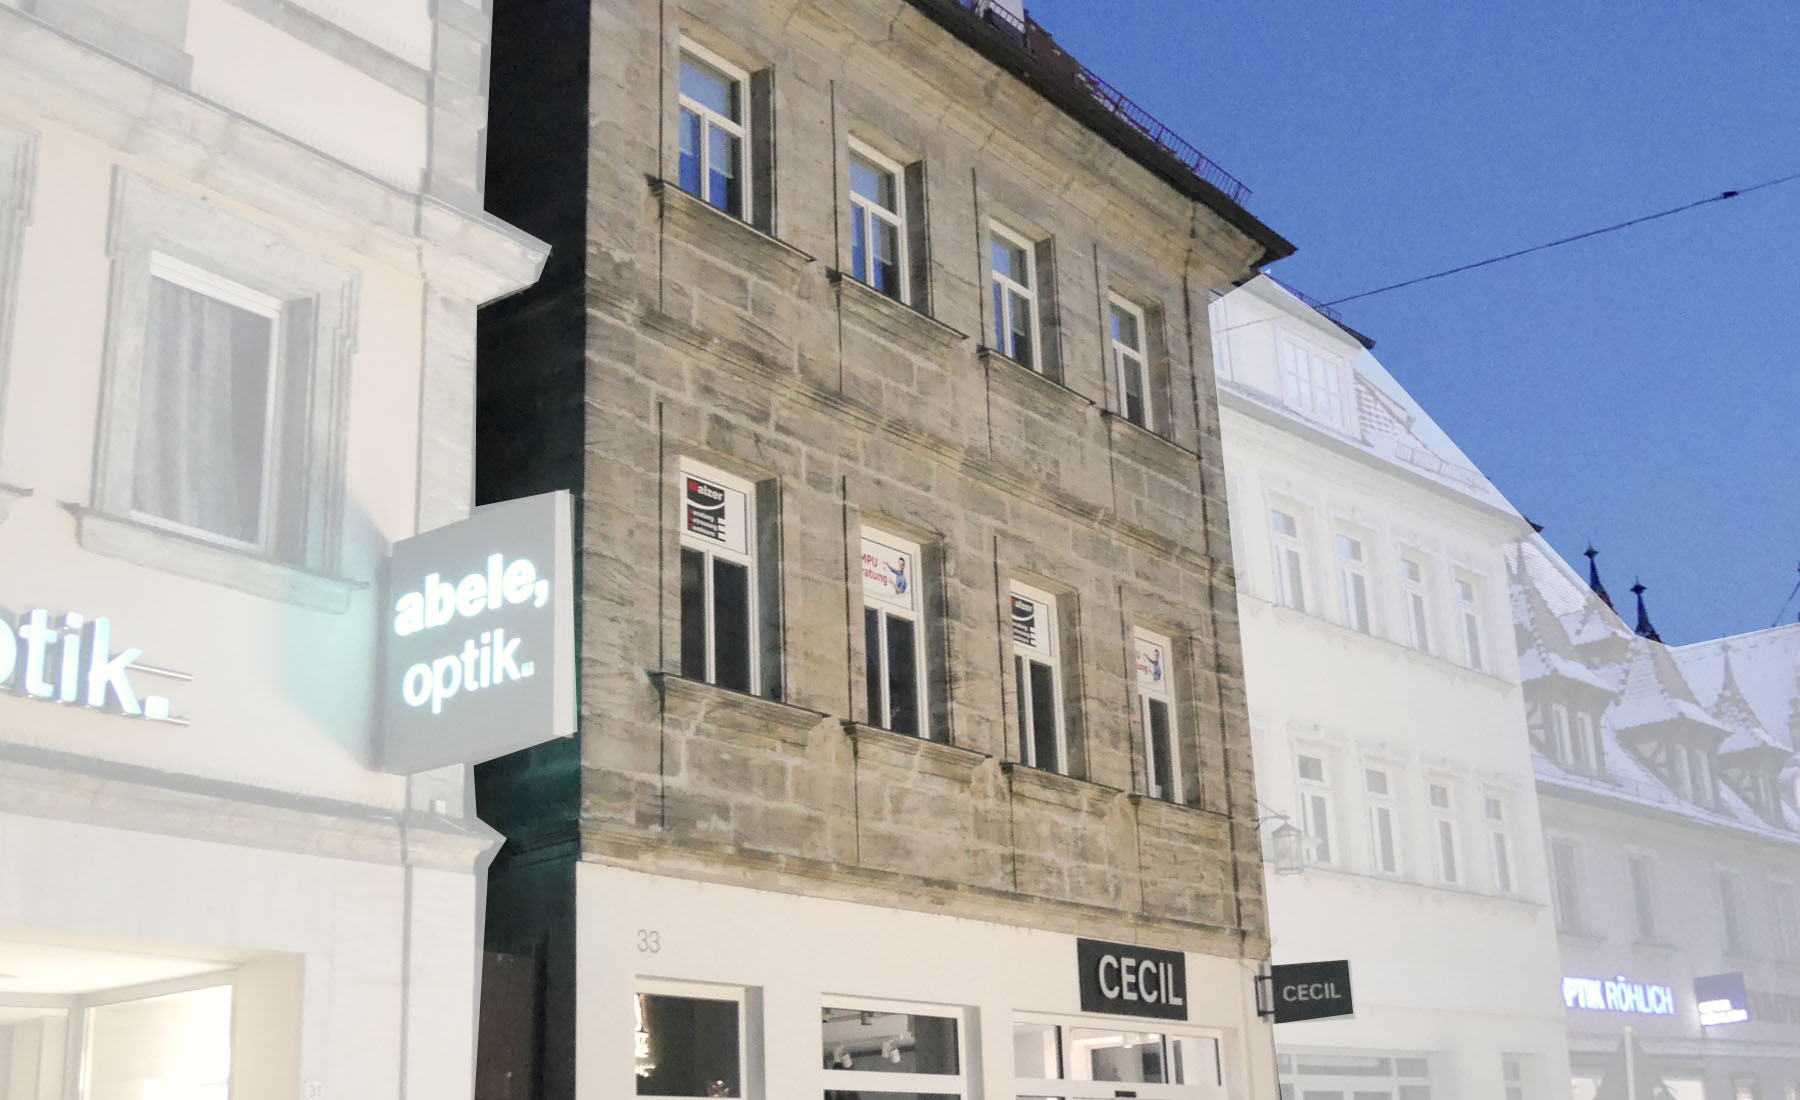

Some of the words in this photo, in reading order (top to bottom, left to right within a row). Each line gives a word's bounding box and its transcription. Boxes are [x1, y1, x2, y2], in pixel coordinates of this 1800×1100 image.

[394, 553, 549, 636] abele,
[402, 627, 535, 714] optik.
[637, 929, 661, 953] 33
[1098, 954, 1183, 1006] CECIL
[1282, 981, 1341, 1002] CECIL
[1604, 975, 1675, 1015] RÖHLICH
